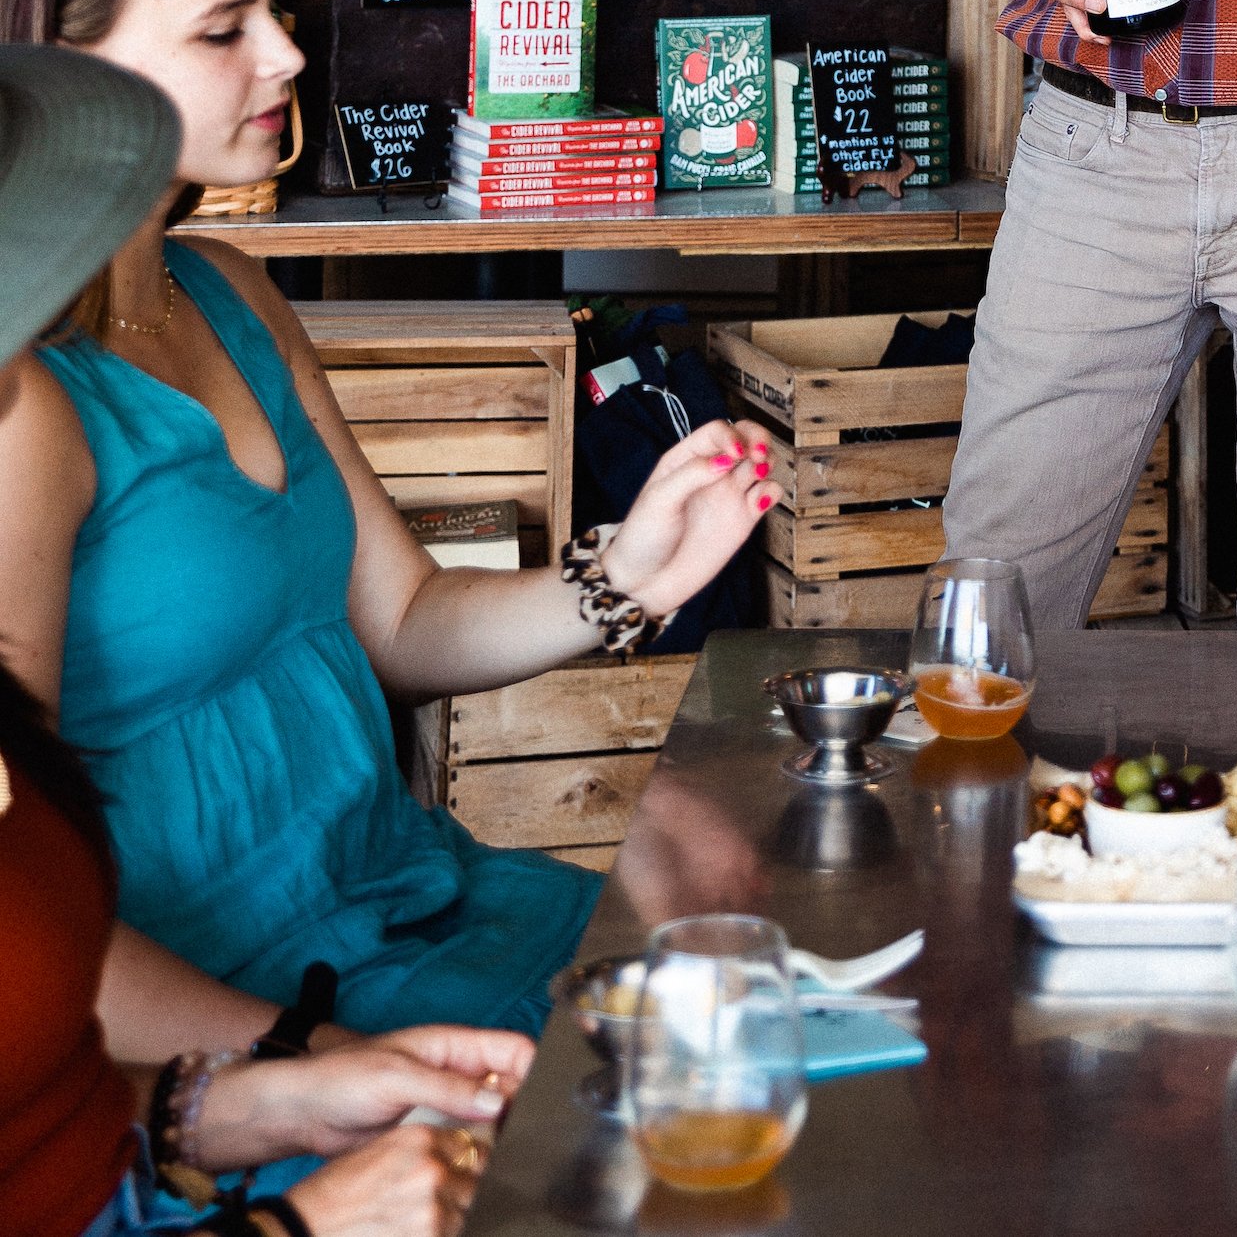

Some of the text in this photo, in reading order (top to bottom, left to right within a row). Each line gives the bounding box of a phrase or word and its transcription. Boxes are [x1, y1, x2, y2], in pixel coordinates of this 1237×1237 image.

[500, 0, 571, 30] CIDER
[500, 34, 573, 56] REVIVAL
[813, 49, 887, 66] American
[834, 67, 876, 85] Cider
[905, 65, 929, 78] CIDER
[497, 74, 571, 88] THE ORCHARD
[672, 56, 759, 119] AMERICAN
[836, 84, 876, 104] Book
[903, 83, 928, 95] CIDER
[702, 84, 762, 127] CIDER
[903, 101, 928, 114] CIDER
[340, 103, 429, 125] The Cider
[833, 105, 873, 134] $22
[361, 120, 425, 141] Revival
[510, 125, 533, 138] CIDER
[534, 124, 564, 136] REVIVAL
[905, 120, 930, 132] CIDER
[373, 138, 415, 156] Book
[509, 144, 531, 156] CIDER
[532, 143, 561, 154] REVIVAL
[829, 136, 878, 149] mentions
[883, 136, 895, 146] us
[905, 137, 929, 150] CIDER
[832, 150, 867, 163] other
[369, 157, 412, 183] $26
[502, 162, 525, 174] CIDER
[526, 161, 555, 173] REVIVAL
[842, 159, 889, 172] ciders!
[500, 179, 522, 191] CIDER
[523, 178, 553, 189] REVIVAL
[501, 196, 524, 208] CIDER
[525, 195, 554, 206] REVIVAL
